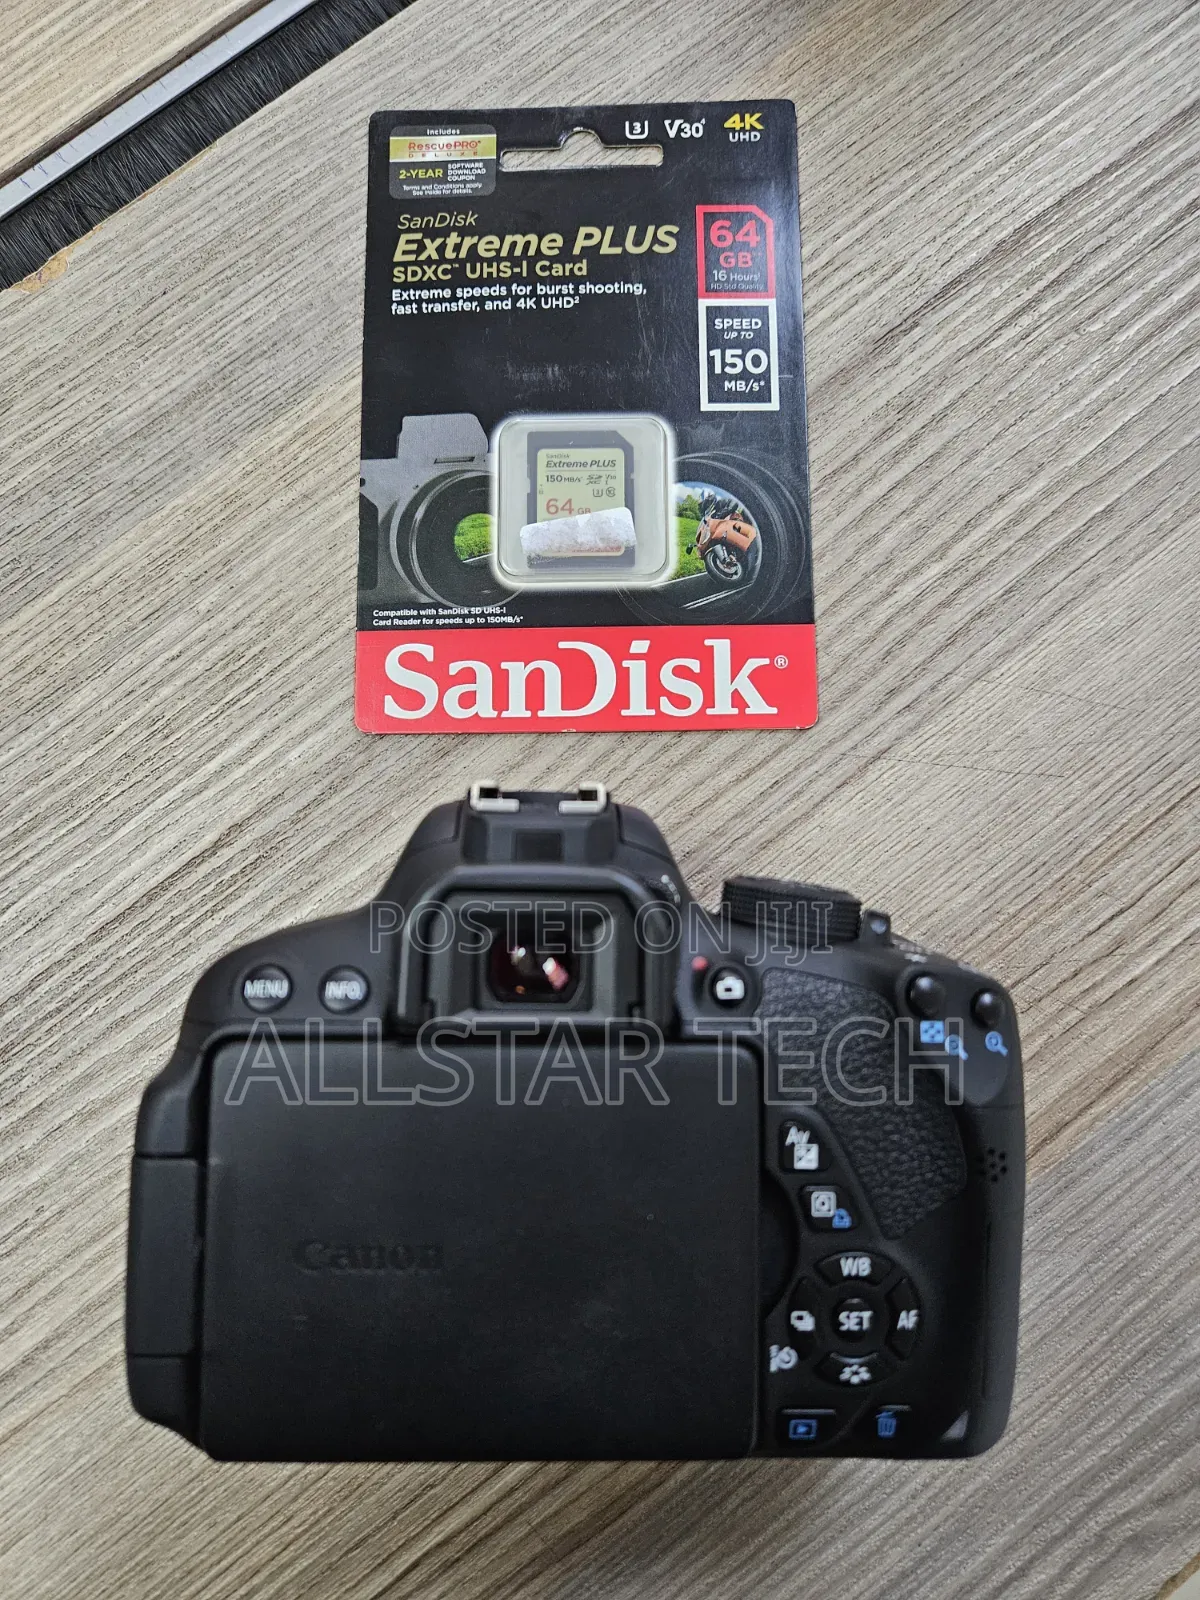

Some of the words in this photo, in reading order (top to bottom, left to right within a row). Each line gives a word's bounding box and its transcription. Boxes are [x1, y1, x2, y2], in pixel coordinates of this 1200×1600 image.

[724, 112, 764, 130] 4K
[427, 128, 460, 136] Includes
[729, 131, 761, 142] UHD
[399, 168, 443, 179] 2-YEAR
[447, 162, 484, 170] SOFTWARE
[447, 168, 486, 176] DOWNLOAD
[397, 210, 479, 230] SanDisk
[709, 219, 761, 248] 64
[392, 231, 564, 262] Extreme
[572, 225, 680, 256] PLUS
[465, 260, 528, 279] UHS-I
[535, 259, 588, 277] Card
[712, 270, 727, 282] 16
[391, 287, 452, 302] Extreme
[456, 283, 507, 300] speeds
[511, 282, 533, 295] for
[536, 282, 575, 295] burst
[578, 280, 647, 297] shooting,
[391, 302, 418, 315] fast
[421, 300, 480, 315] transfer,
[484, 297, 512, 310] and
[516, 297, 537, 309] 4K
[714, 318, 763, 330] SPEED
[723, 332, 738, 340] UP
[740, 332, 754, 340] TO
[709, 348, 769, 375] 150
[545, 460, 588, 468] Extreme
[589, 459, 617, 467] PLUS
[545, 474, 563, 483] 150
[545, 498, 575, 515] 64
[577, 507, 592, 515] GB
[373, 609, 418, 619] Compatible
[419, 608, 437, 616] with
[437, 607, 469, 616] SanDisk
[483, 606, 506, 614] UHS-I
[373, 618, 392, 626] Card
[393, 617, 421, 626] Reader
[422, 617, 434, 625] for
[435, 616, 463, 626] speeds
[464, 617, 476, 625] up
[476, 616, 486, 624] to
[243, 978, 290, 999] MENU
[839, 1256, 872, 1277] WB
[838, 1310, 875, 1332] SET
[897, 1309, 921, 1331] AF
